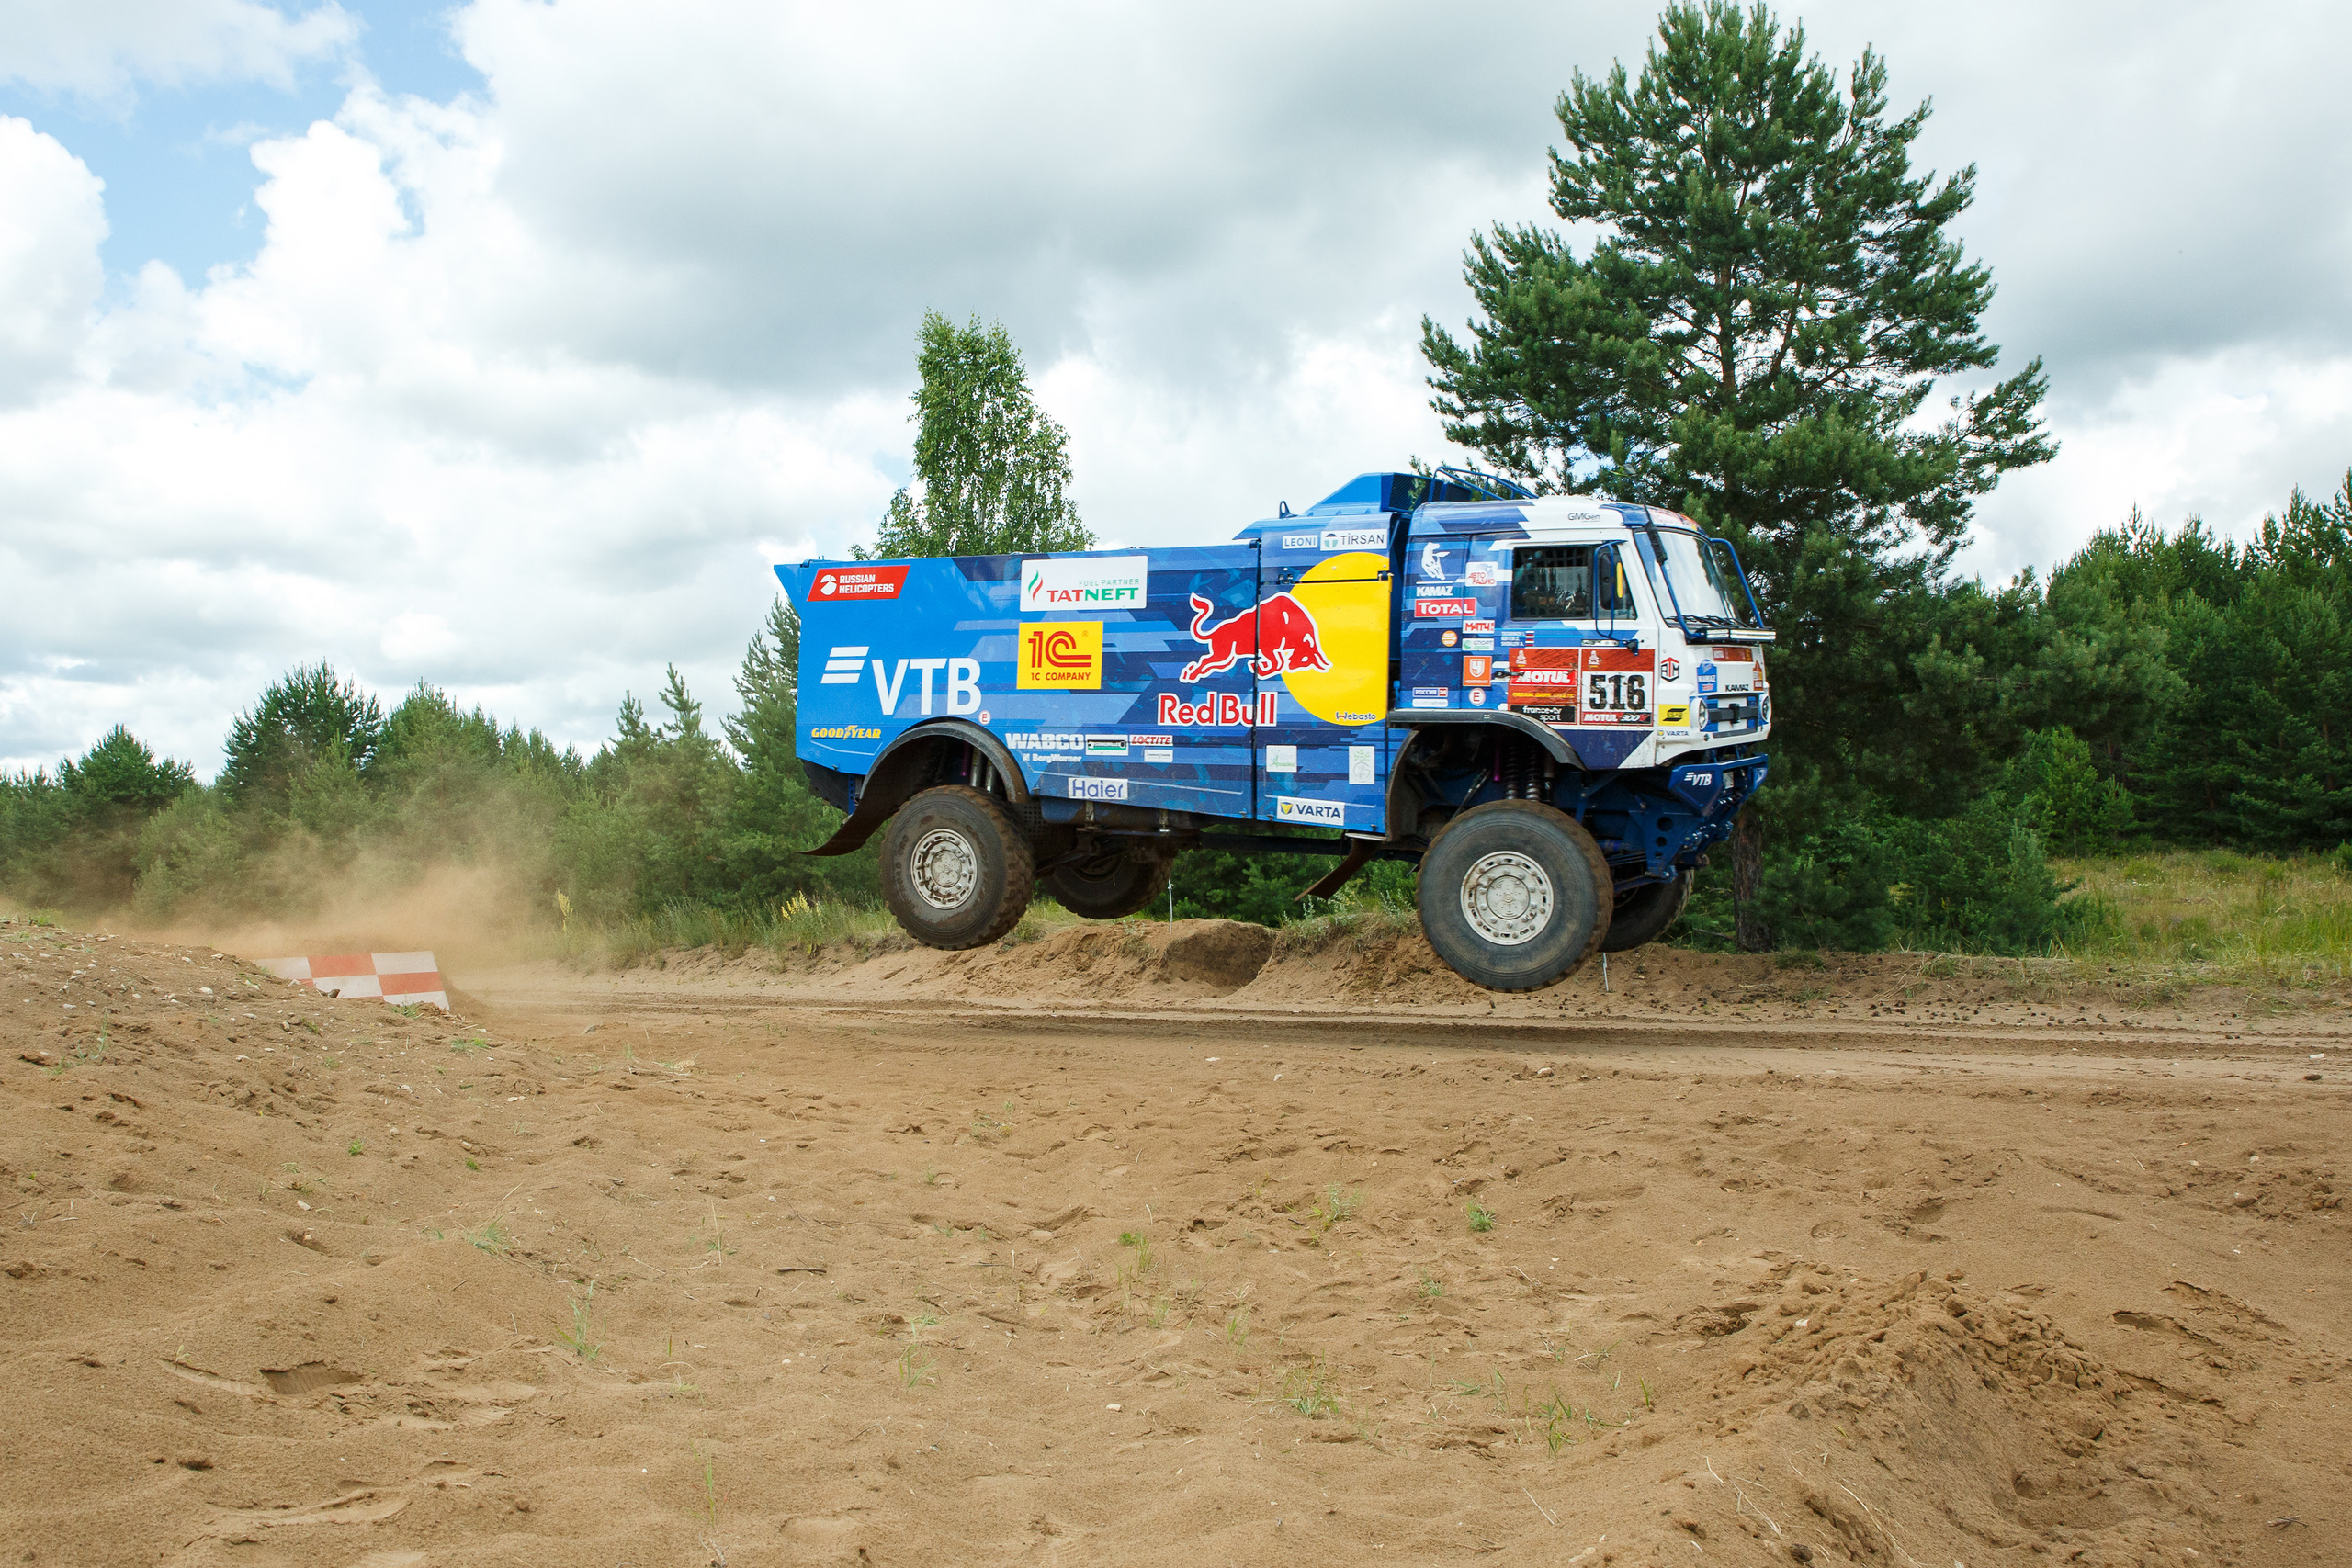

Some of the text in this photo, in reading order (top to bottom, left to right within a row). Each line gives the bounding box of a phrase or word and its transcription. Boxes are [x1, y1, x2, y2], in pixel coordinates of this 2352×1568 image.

[1284, 537, 1317, 547] LEONI
[839, 574, 876, 584] RUSSIAN
[1102, 578, 1139, 586] PARTNER
[839, 583, 895, 594] HELICOPTERS
[1416, 586, 1453, 597] KAMAZ
[1046, 587, 1139, 603] TATNEFT
[1027, 630, 1092, 669] 1C
[1031, 672, 1091, 681] 1C COMPANY
[1515, 670, 1571, 684] MOTUL
[871, 657, 982, 716] VTB
[1724, 683, 1750, 692] KAMAZ
[1473, 691, 1480, 702] E
[1589, 674, 1645, 711] 516
[981, 713, 989, 723] E
[1335, 711, 1376, 721] Webasto
[1539, 714, 1562, 723] sport
[1583, 714, 1618, 722] MOTUL
[810, 725, 882, 740] GOODYEAR
[1004, 732, 1085, 750] WABCO
[1131, 736, 1171, 745] LOCTITE
[1032, 753, 1082, 764] BorgWarner
[1691, 773, 1713, 786] VTB
[1072, 779, 1124, 799] Haier
[1296, 804, 1341, 818] VARTA
